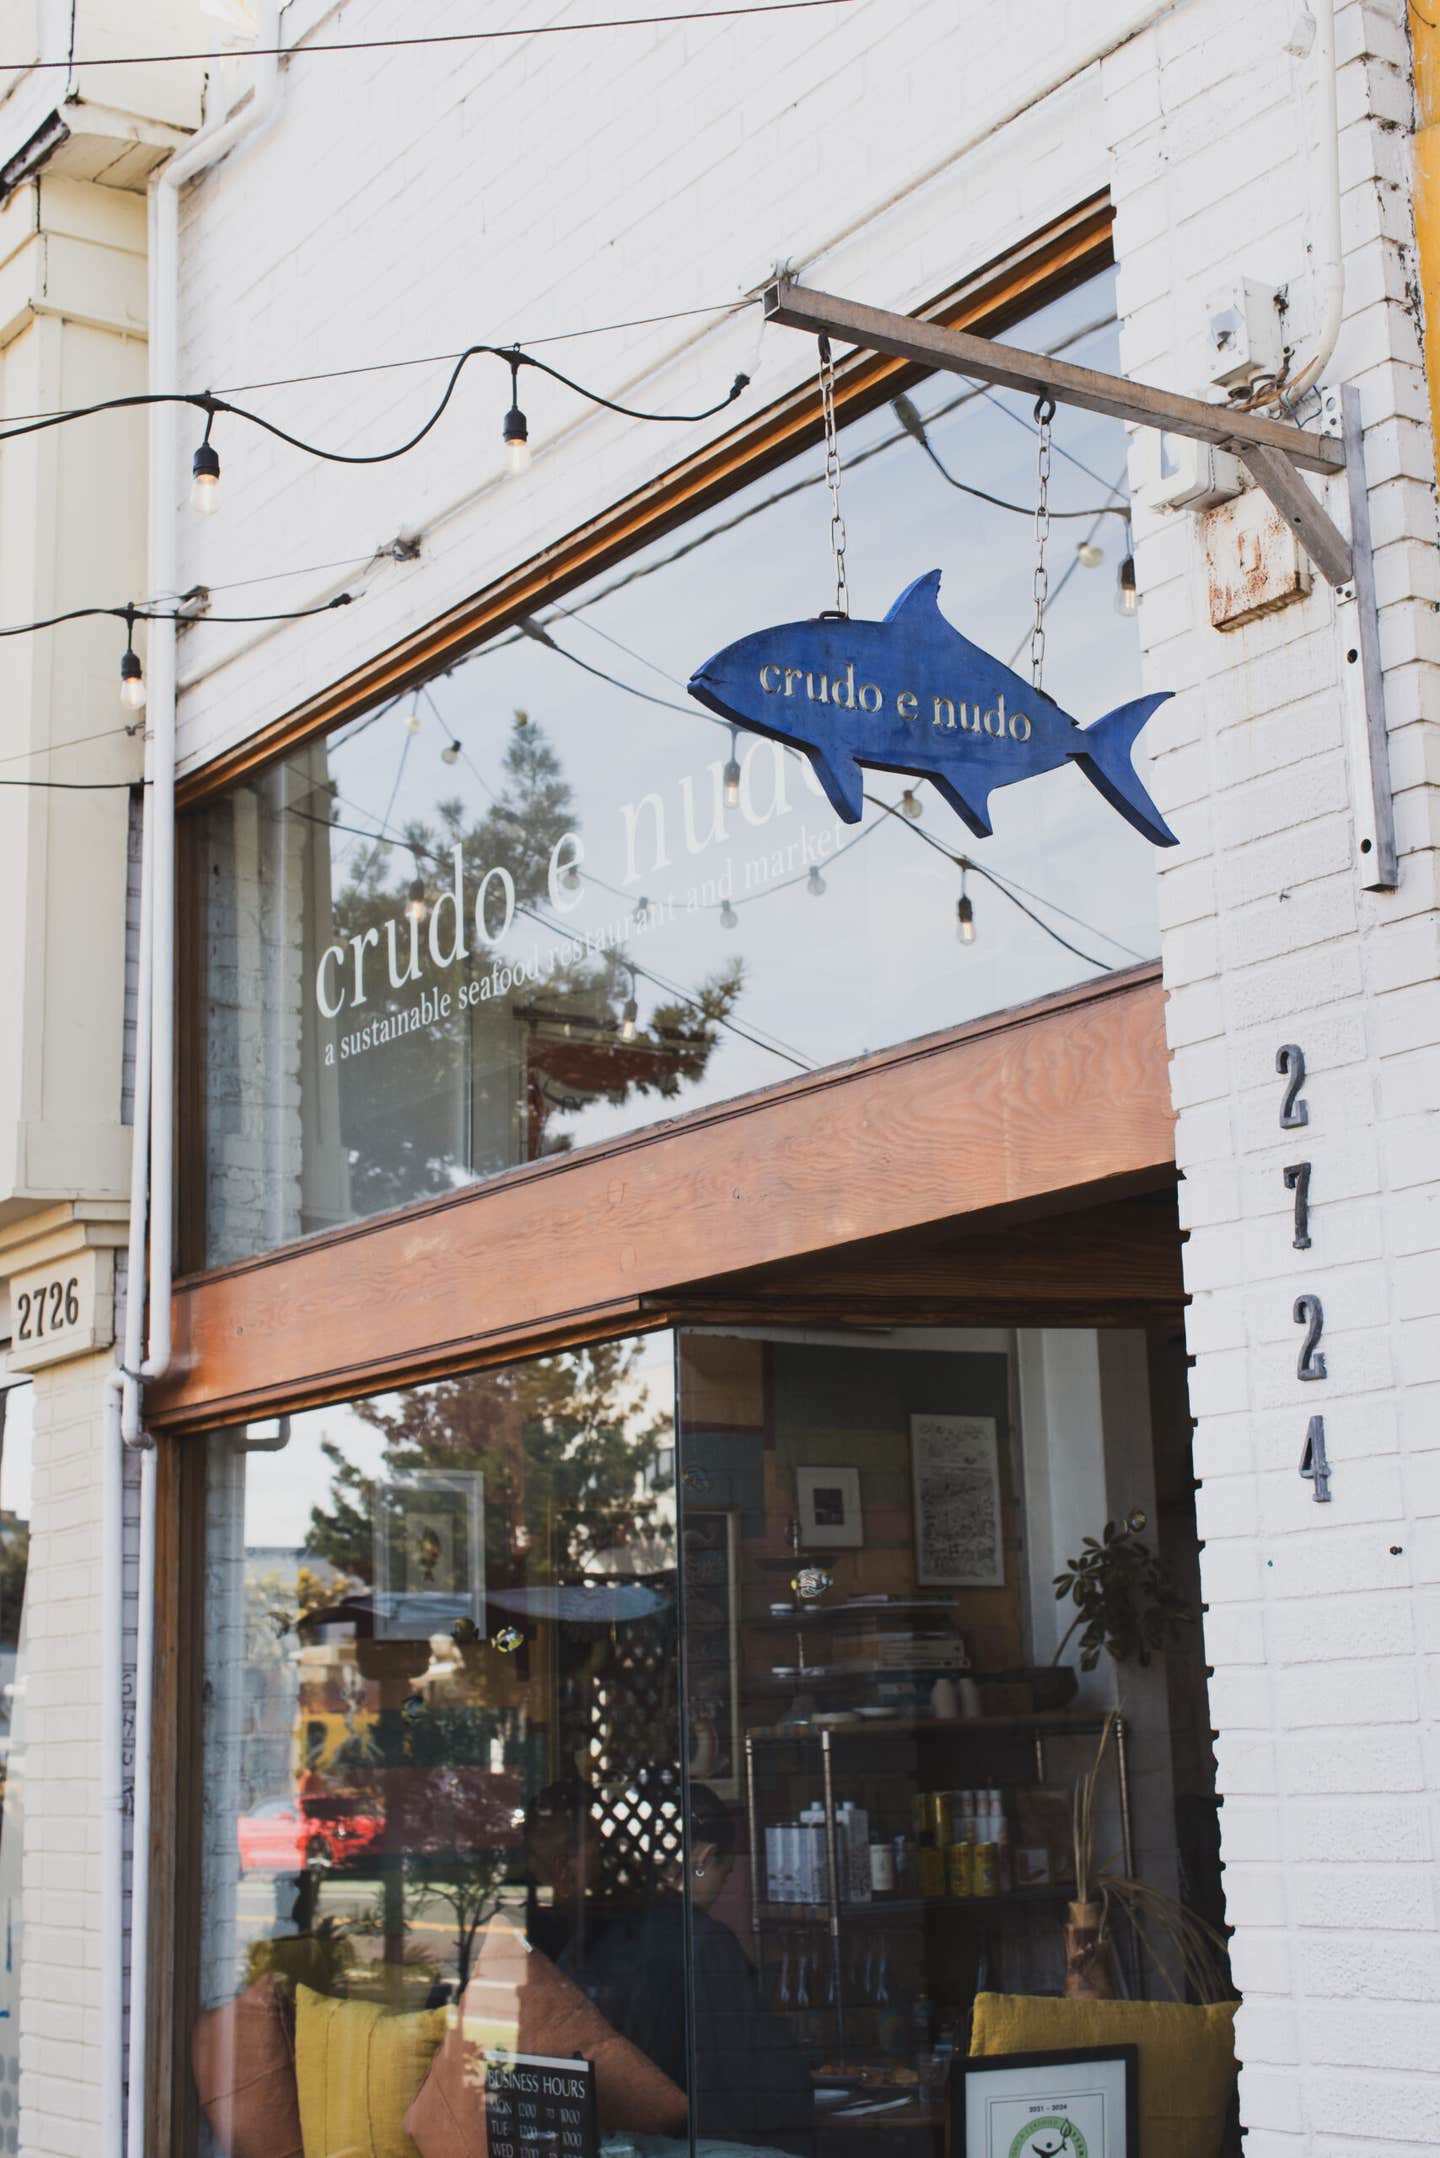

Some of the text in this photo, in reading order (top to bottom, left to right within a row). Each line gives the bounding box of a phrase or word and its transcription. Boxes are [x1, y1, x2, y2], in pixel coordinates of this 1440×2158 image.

[759, 662, 1032, 742] crudo e nudo
[316, 844, 516, 1019] crudo
[548, 831, 585, 912] e
[324, 818, 845, 1066] a sustainable seafood restaurant and market
[18, 1278, 79, 1340] 2726
[487, 2069, 585, 2099] BUSINESS HOURS
